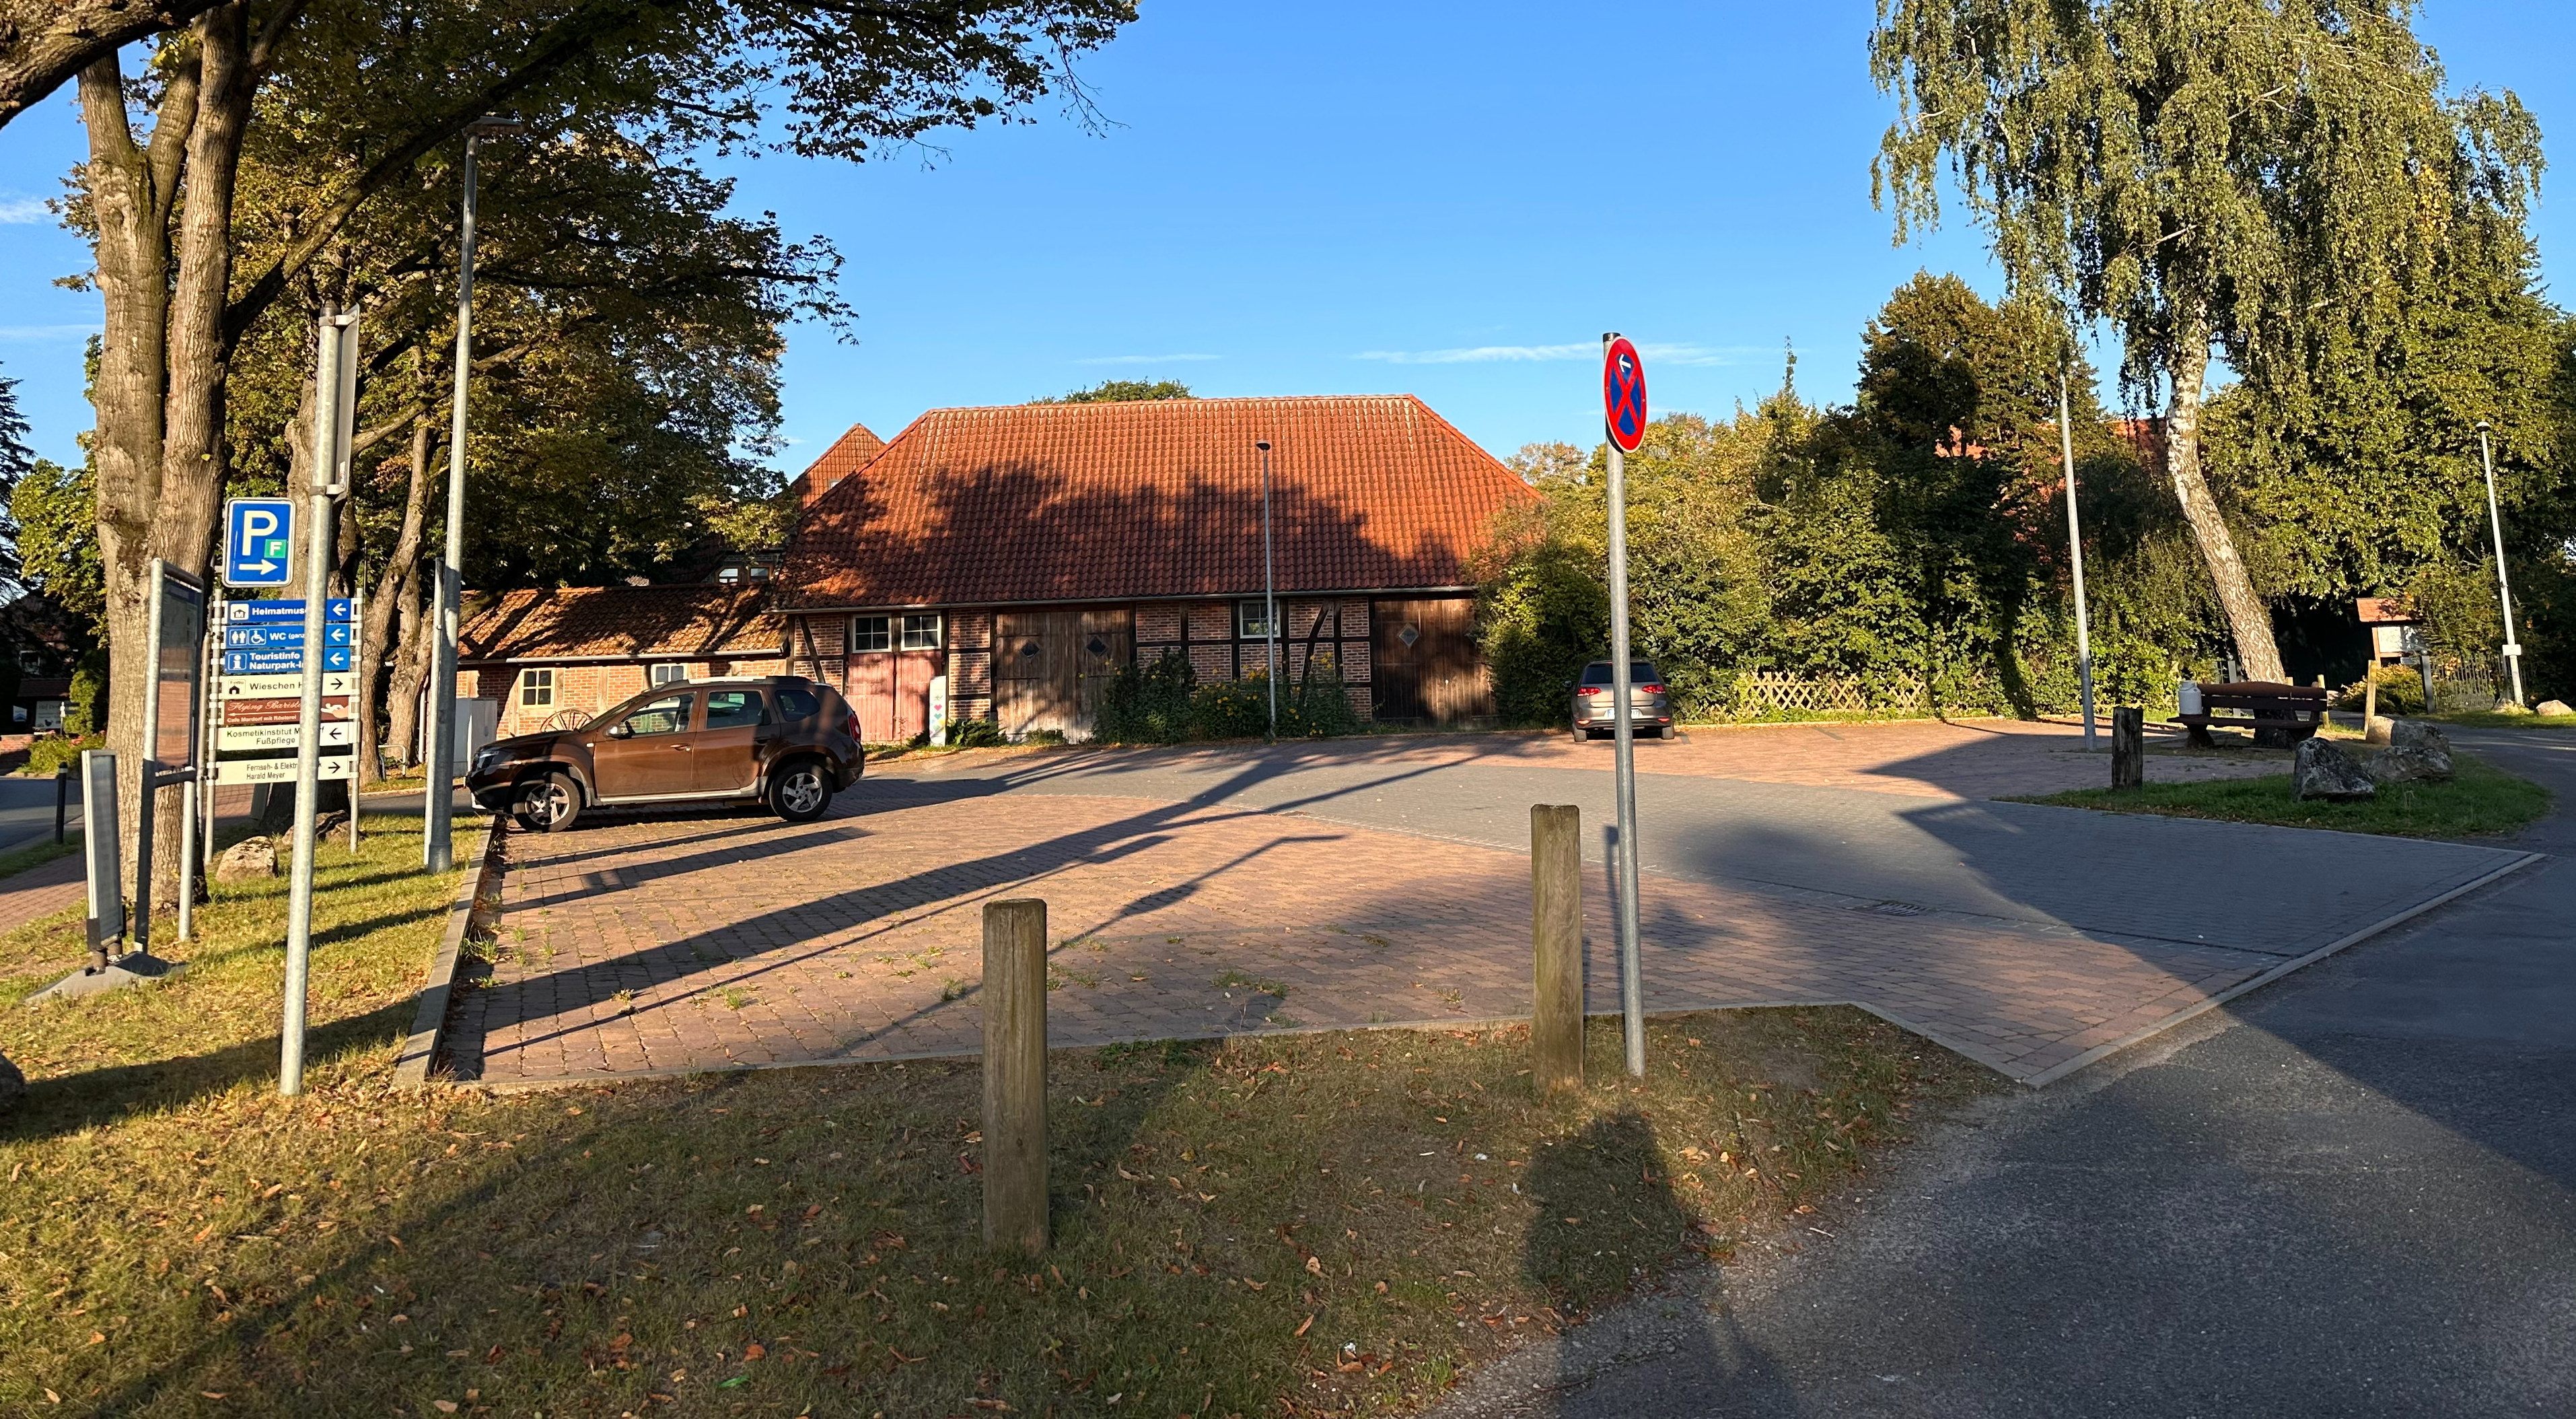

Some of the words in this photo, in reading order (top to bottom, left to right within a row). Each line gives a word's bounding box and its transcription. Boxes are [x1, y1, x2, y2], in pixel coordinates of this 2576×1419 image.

[242, 510, 278, 556] P
[270, 541, 283, 556] F
[252, 607, 307, 615] Heimatmus
[269, 632, 287, 640] WC
[250, 652, 300, 660] Touristinfo
[249, 660, 304, 670] Naturpark-I
[250, 682, 295, 690] Wieschen
[227, 702, 262, 712] Flying
[256, 737, 295, 745] Fußpflege
[267, 771, 285, 780] Meyer
